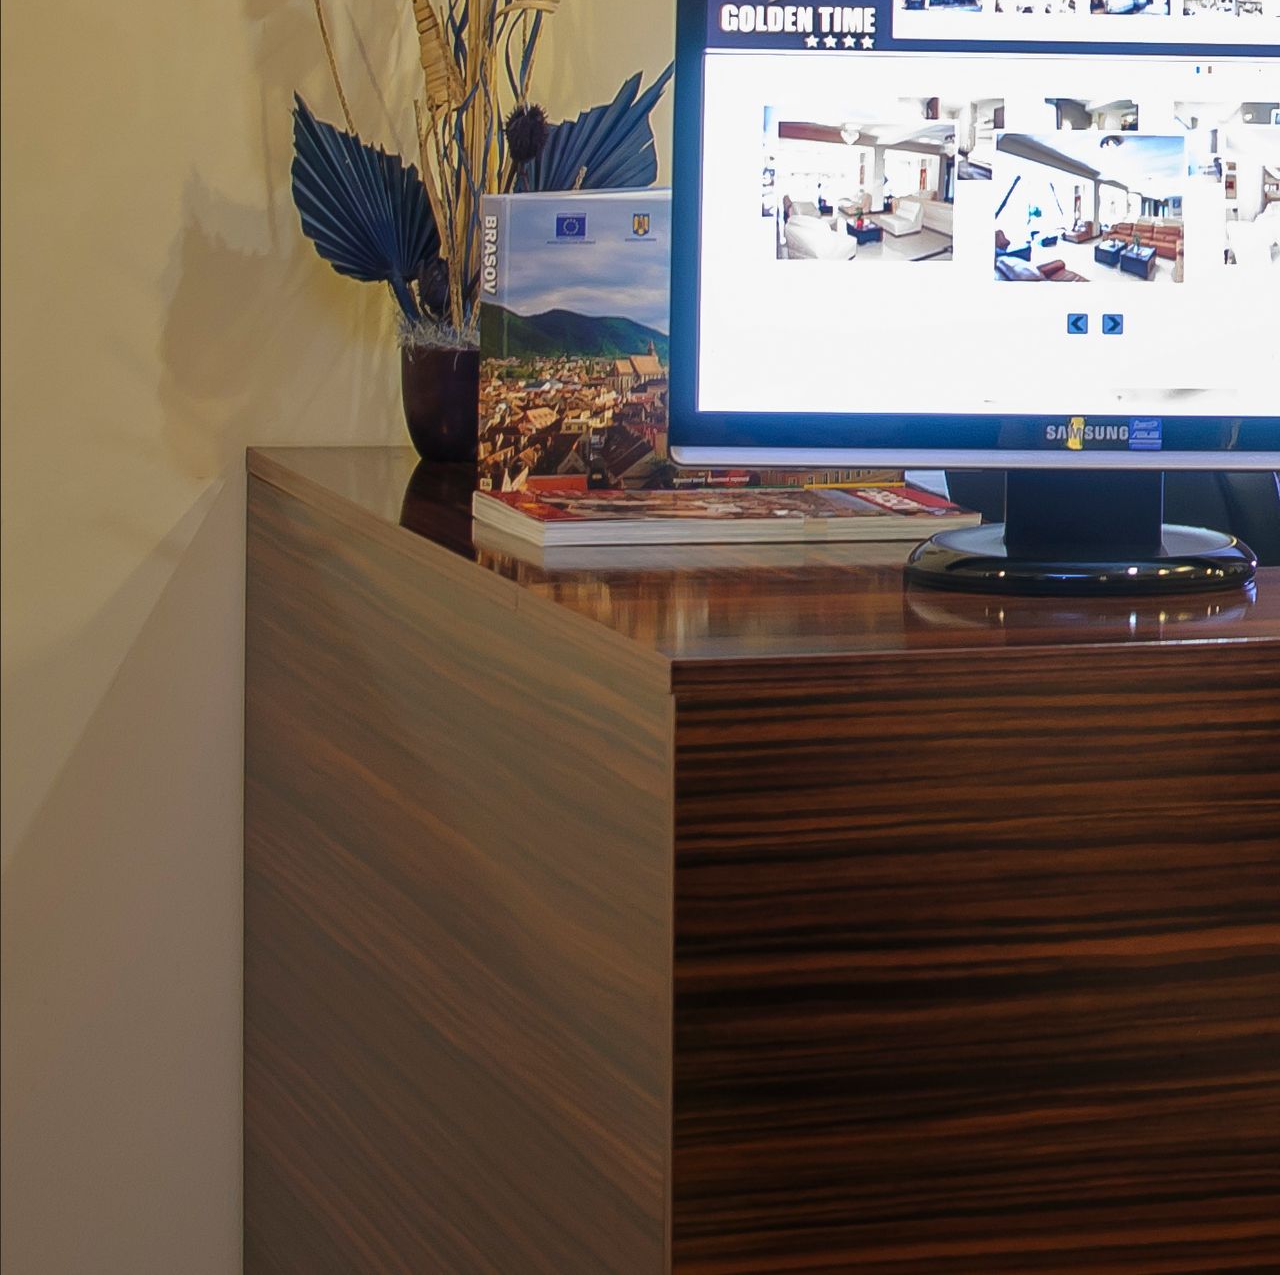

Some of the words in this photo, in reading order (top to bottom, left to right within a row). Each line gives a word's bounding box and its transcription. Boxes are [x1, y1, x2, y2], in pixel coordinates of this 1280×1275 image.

[720, 3, 814, 33] GOLDEN
[818, 6, 876, 34] TIME
[1046, 424, 1129, 441] SAMSUNG
